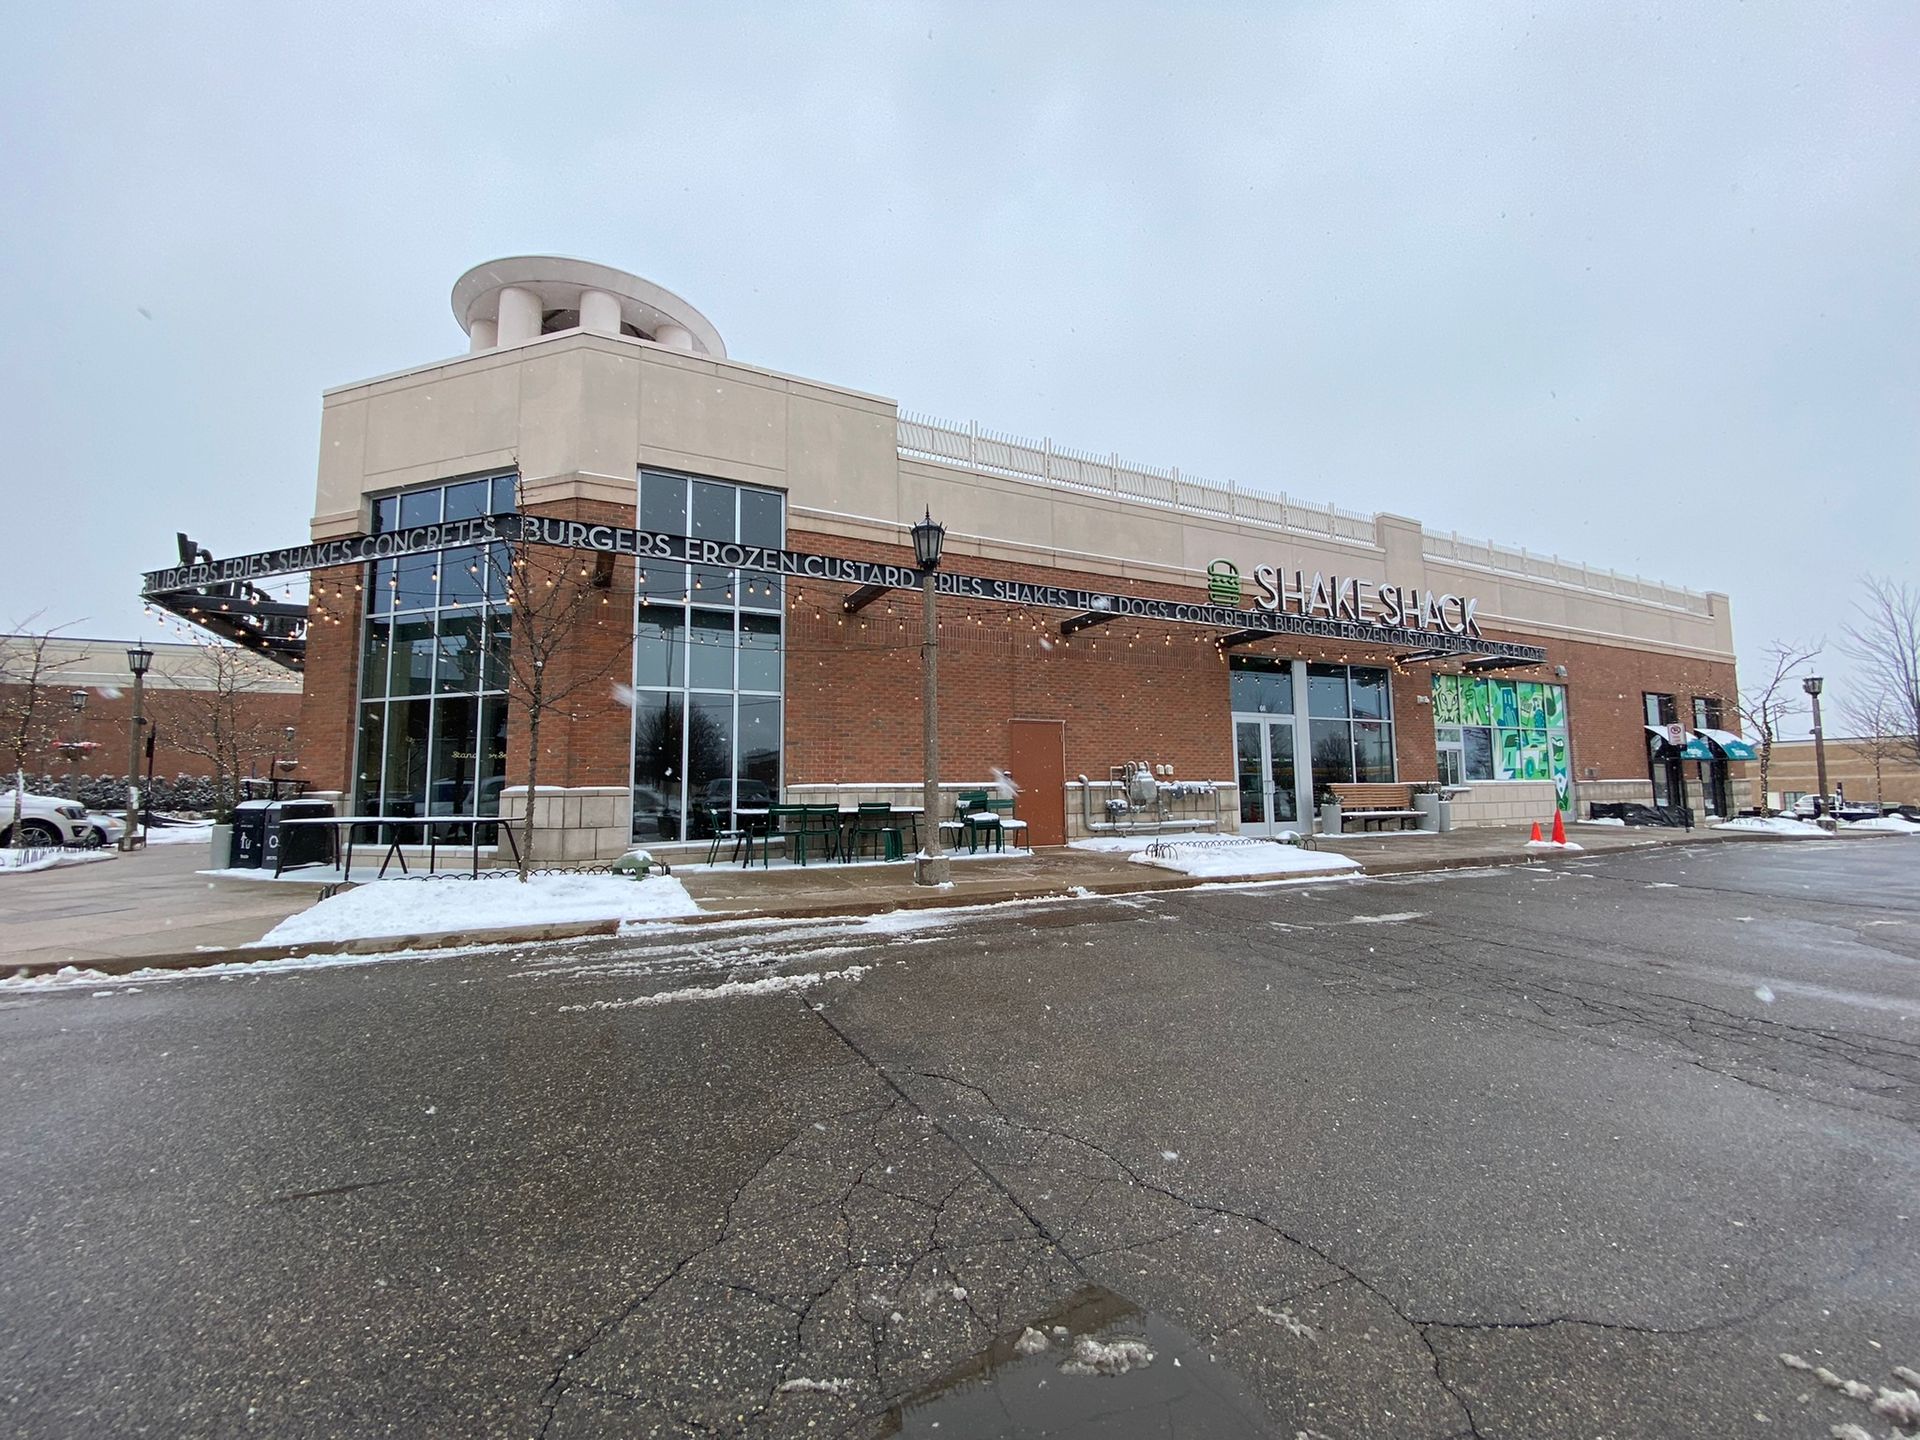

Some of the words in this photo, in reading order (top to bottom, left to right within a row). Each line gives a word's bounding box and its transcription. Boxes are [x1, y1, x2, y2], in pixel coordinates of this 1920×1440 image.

[145, 562, 218, 591] BURGERS
[223, 553, 270, 580] FRIES
[278, 540, 352, 571] SHAKES
[360, 516, 496, 559] CONCRETES
[521, 515, 672, 559] BURGERS
[684, 537, 798, 576] FROZEN
[803, 555, 916, 588] CUSTARD
[993, 581, 1069, 608] SHAKES
[1118, 597, 1169, 618] DOGS
[1175, 604, 1270, 631] CONCRETES
[1275, 616, 1337, 637] BURGERS
[1340, 622, 1390, 643] FROZEN
[1390, 629, 1442, 649] CUSTARD
[1444, 636, 1472, 653] FRIES
[1475, 640, 1509, 657] CONES
[1253, 562, 1377, 625] SHAKE
[1378, 582, 1483, 636] SHACK
